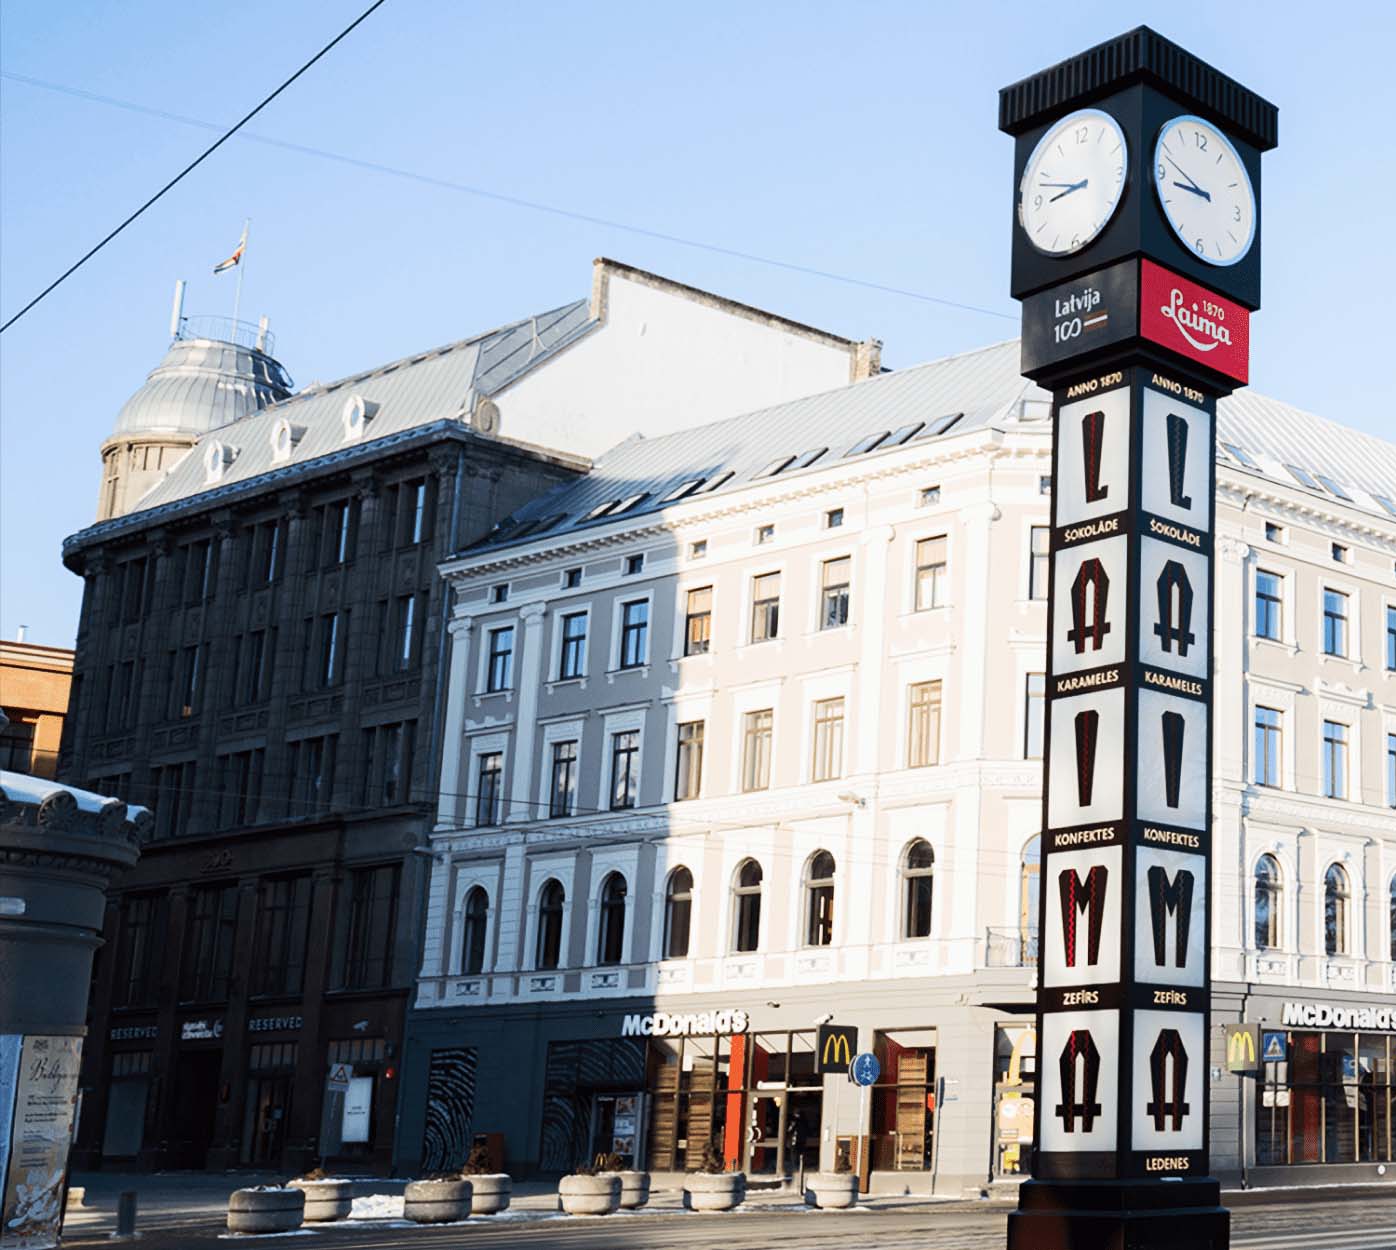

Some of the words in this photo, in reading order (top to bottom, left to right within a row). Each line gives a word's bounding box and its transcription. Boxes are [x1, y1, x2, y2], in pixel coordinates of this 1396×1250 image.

[1075, 126, 1089, 144] 12
[1194, 131, 1208, 152] 12
[1157, 163, 1166, 180] 9
[1034, 194, 1044, 212] 9
[1232, 205, 1241, 222] 3
[1195, 238, 1205, 255] 6
[1055, 288, 1101, 318] Latvija
[1202, 300, 1225, 321] 1870
[1160, 288, 1233, 352] Laima
[1066, 379, 1099, 398] ANNO
[1100, 371, 1123, 388] 1870
[1151, 373, 1182, 395] ANNO
[1183, 386, 1205, 404] 1870
[1057, 670, 1120, 692] KARAMELES
[1144, 671, 1203, 696] KARAMELES
[1055, 827, 1116, 847] KONFEKTES
[1143, 827, 1200, 848] KONFEKTES
[248, 1016, 303, 1032] RESERVED
[622, 1009, 750, 1037] McDonald's
[1146, 1157, 1190, 1171] LEDENES
